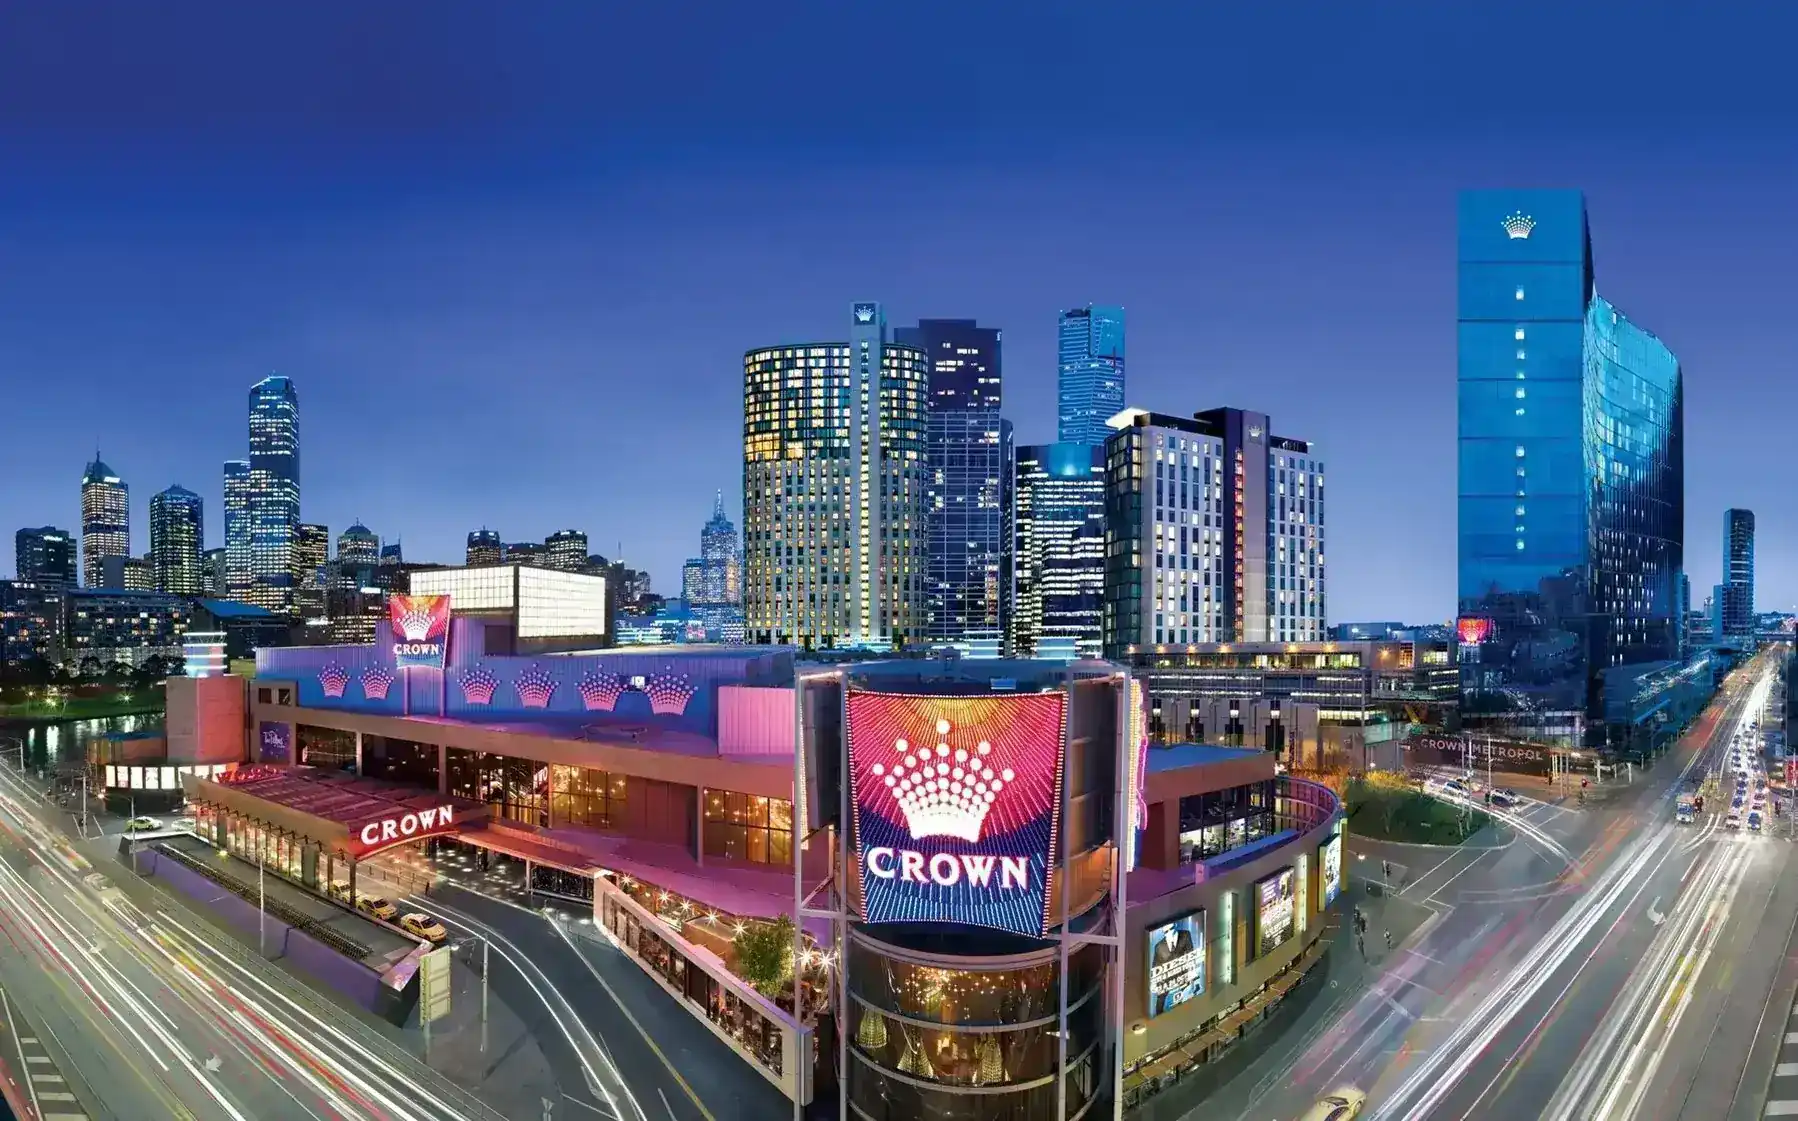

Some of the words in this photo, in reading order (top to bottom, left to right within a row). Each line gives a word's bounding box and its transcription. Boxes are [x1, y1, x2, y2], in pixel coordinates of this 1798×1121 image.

[393, 643, 440, 655] CROWN
[1472, 744, 1544, 761] METROPOL
[360, 804, 453, 845] CROWN
[867, 846, 1028, 890] CROWN
